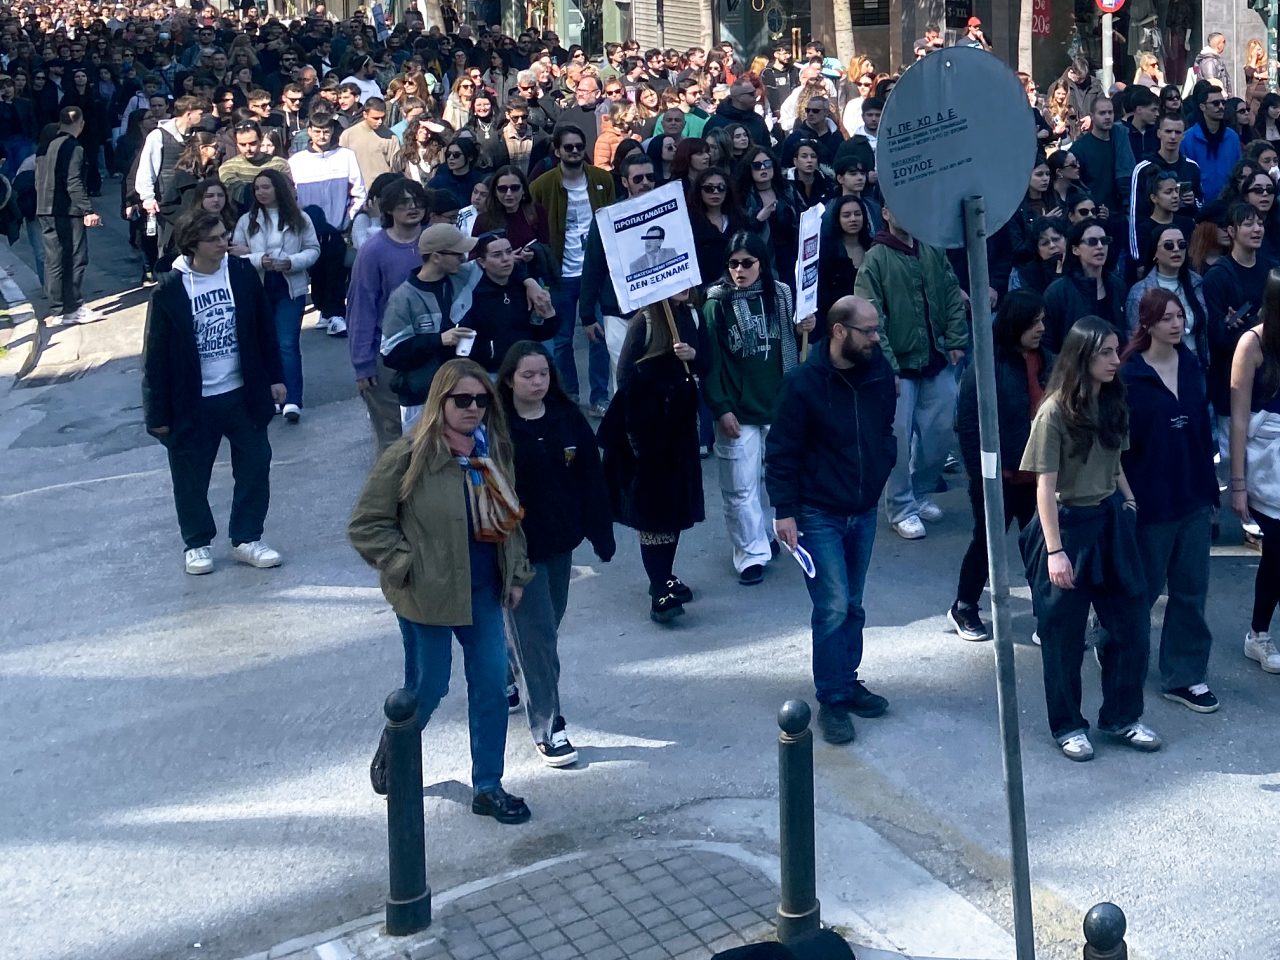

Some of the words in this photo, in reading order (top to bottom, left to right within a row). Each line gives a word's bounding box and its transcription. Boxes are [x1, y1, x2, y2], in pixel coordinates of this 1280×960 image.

[892, 158, 935, 180] ΣΟΥΛΟΣ
[629, 280, 648, 292] ΔΕΝ
[649, 261, 690, 285] ΞΕΧΝΑΜΕ
